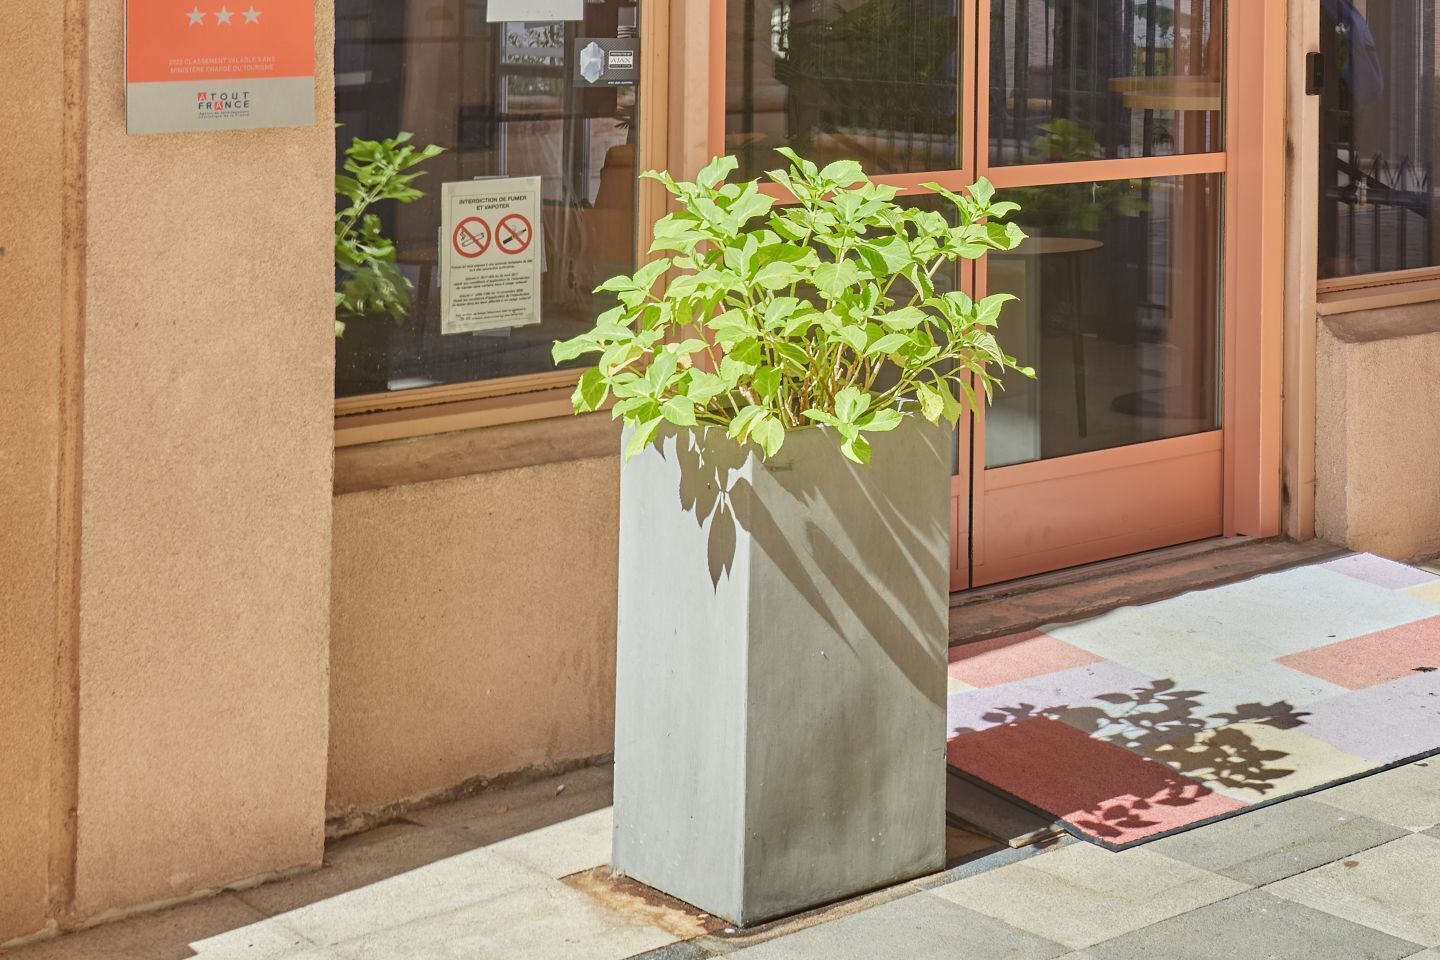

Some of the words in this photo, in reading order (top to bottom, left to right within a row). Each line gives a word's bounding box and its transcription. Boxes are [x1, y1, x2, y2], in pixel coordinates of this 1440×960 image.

[197, 91, 250, 102] ATOUT
[198, 100, 250, 111] FRANCE
[458, 197, 498, 205] INTERDICTION
